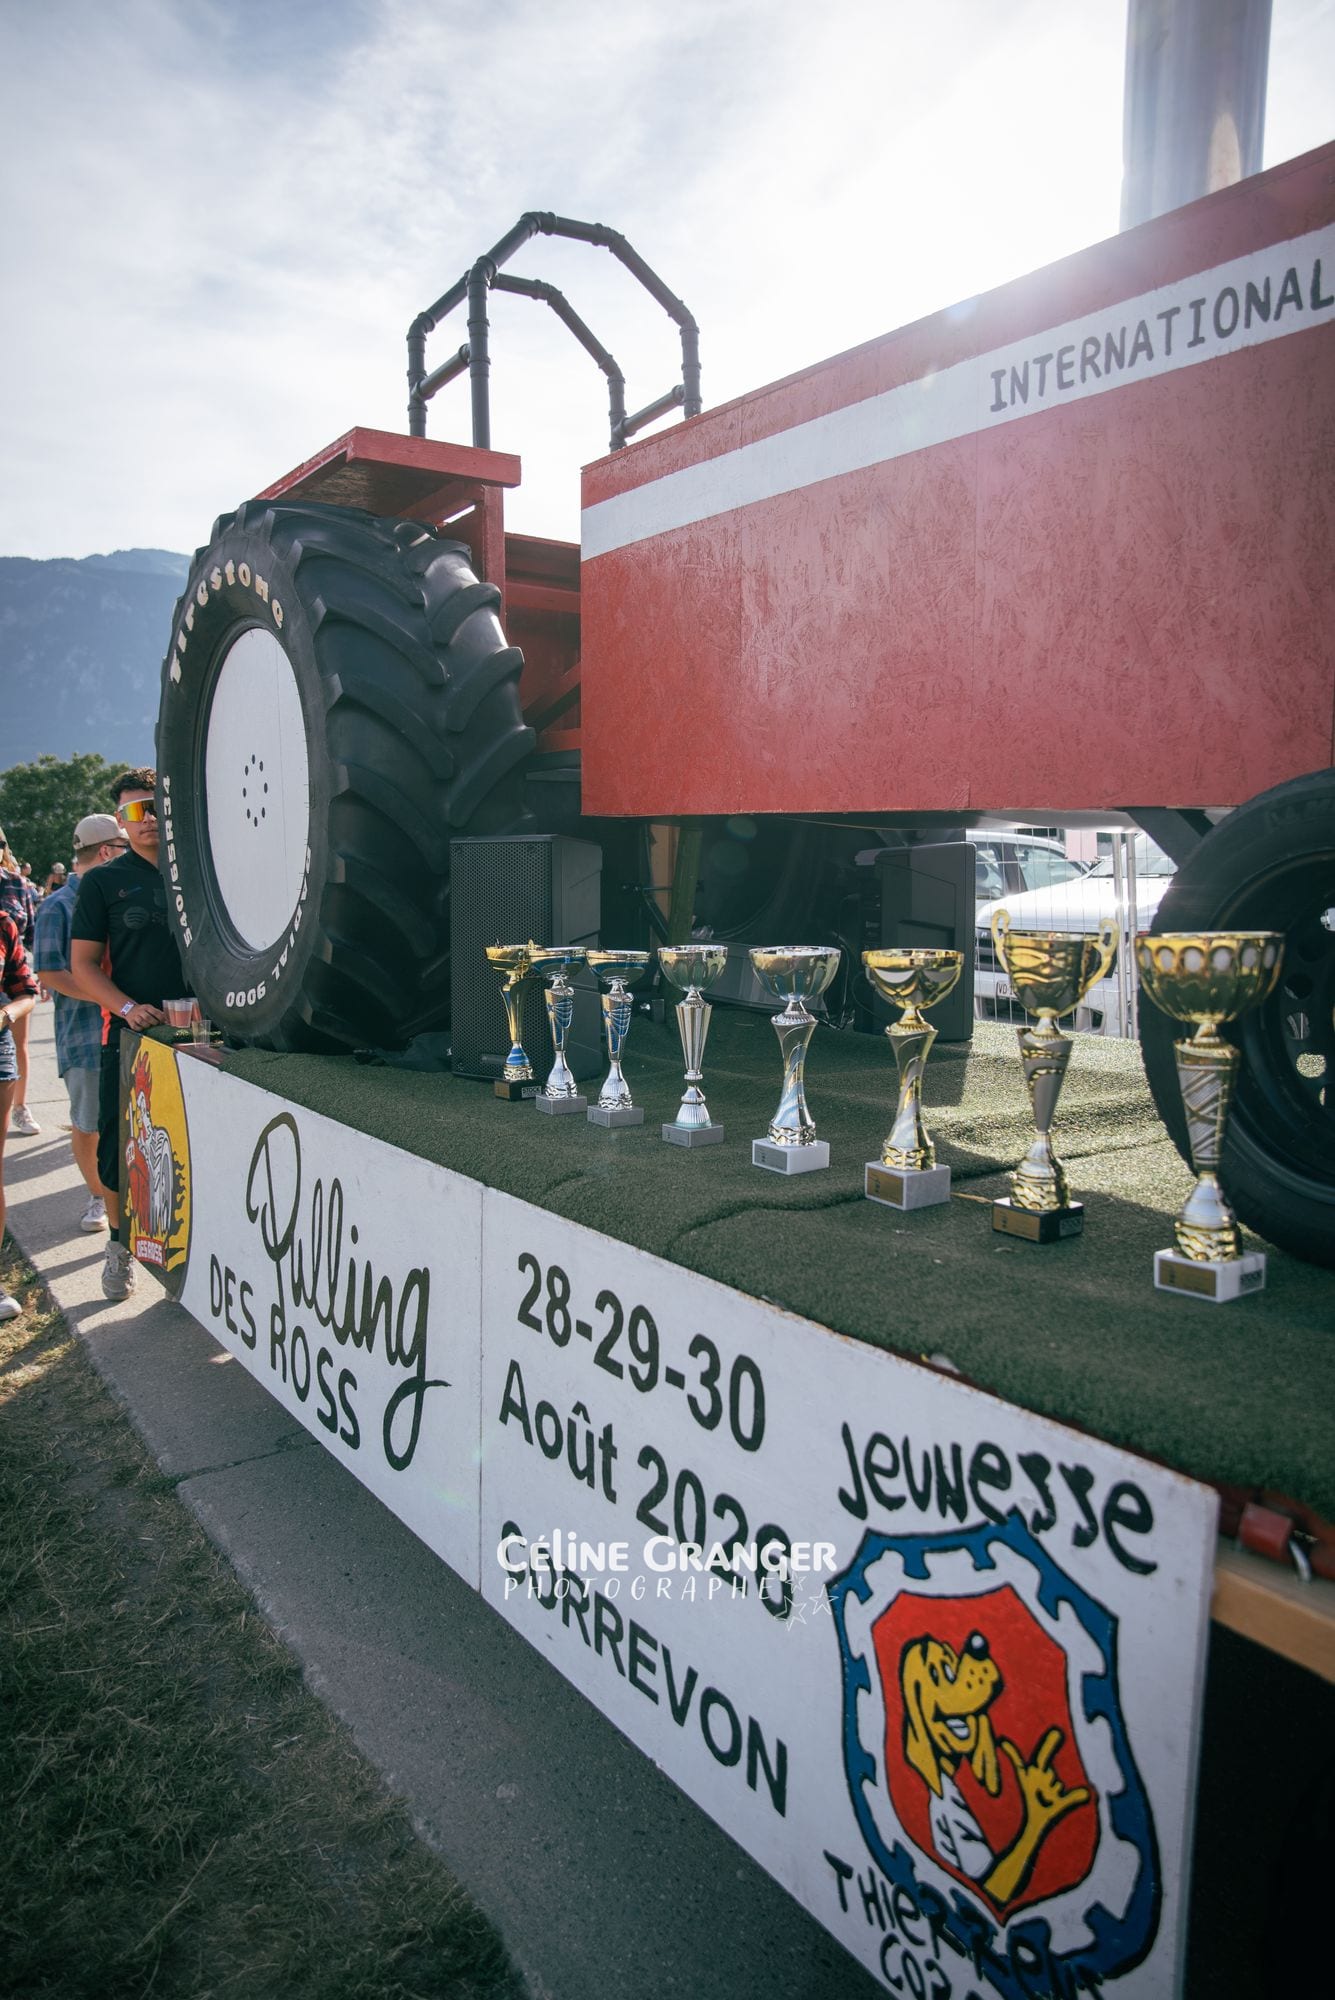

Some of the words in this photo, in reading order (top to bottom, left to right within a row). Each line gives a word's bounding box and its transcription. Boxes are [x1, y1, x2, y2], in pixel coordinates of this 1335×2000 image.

[989, 258, 1335, 413] INTERNATIONAL
[169, 559, 284, 686] Firestone
[210, 1253, 256, 1350] DES
[270, 1303, 361, 1450] ROSS
[246, 1111, 452, 1471] Pulling
[517, 1251, 766, 1453] 28-29-30
[498, 1359, 618, 1504] Août
[636, 1445, 794, 1621] 2026
[501, 1520, 788, 1819] CORREVON
